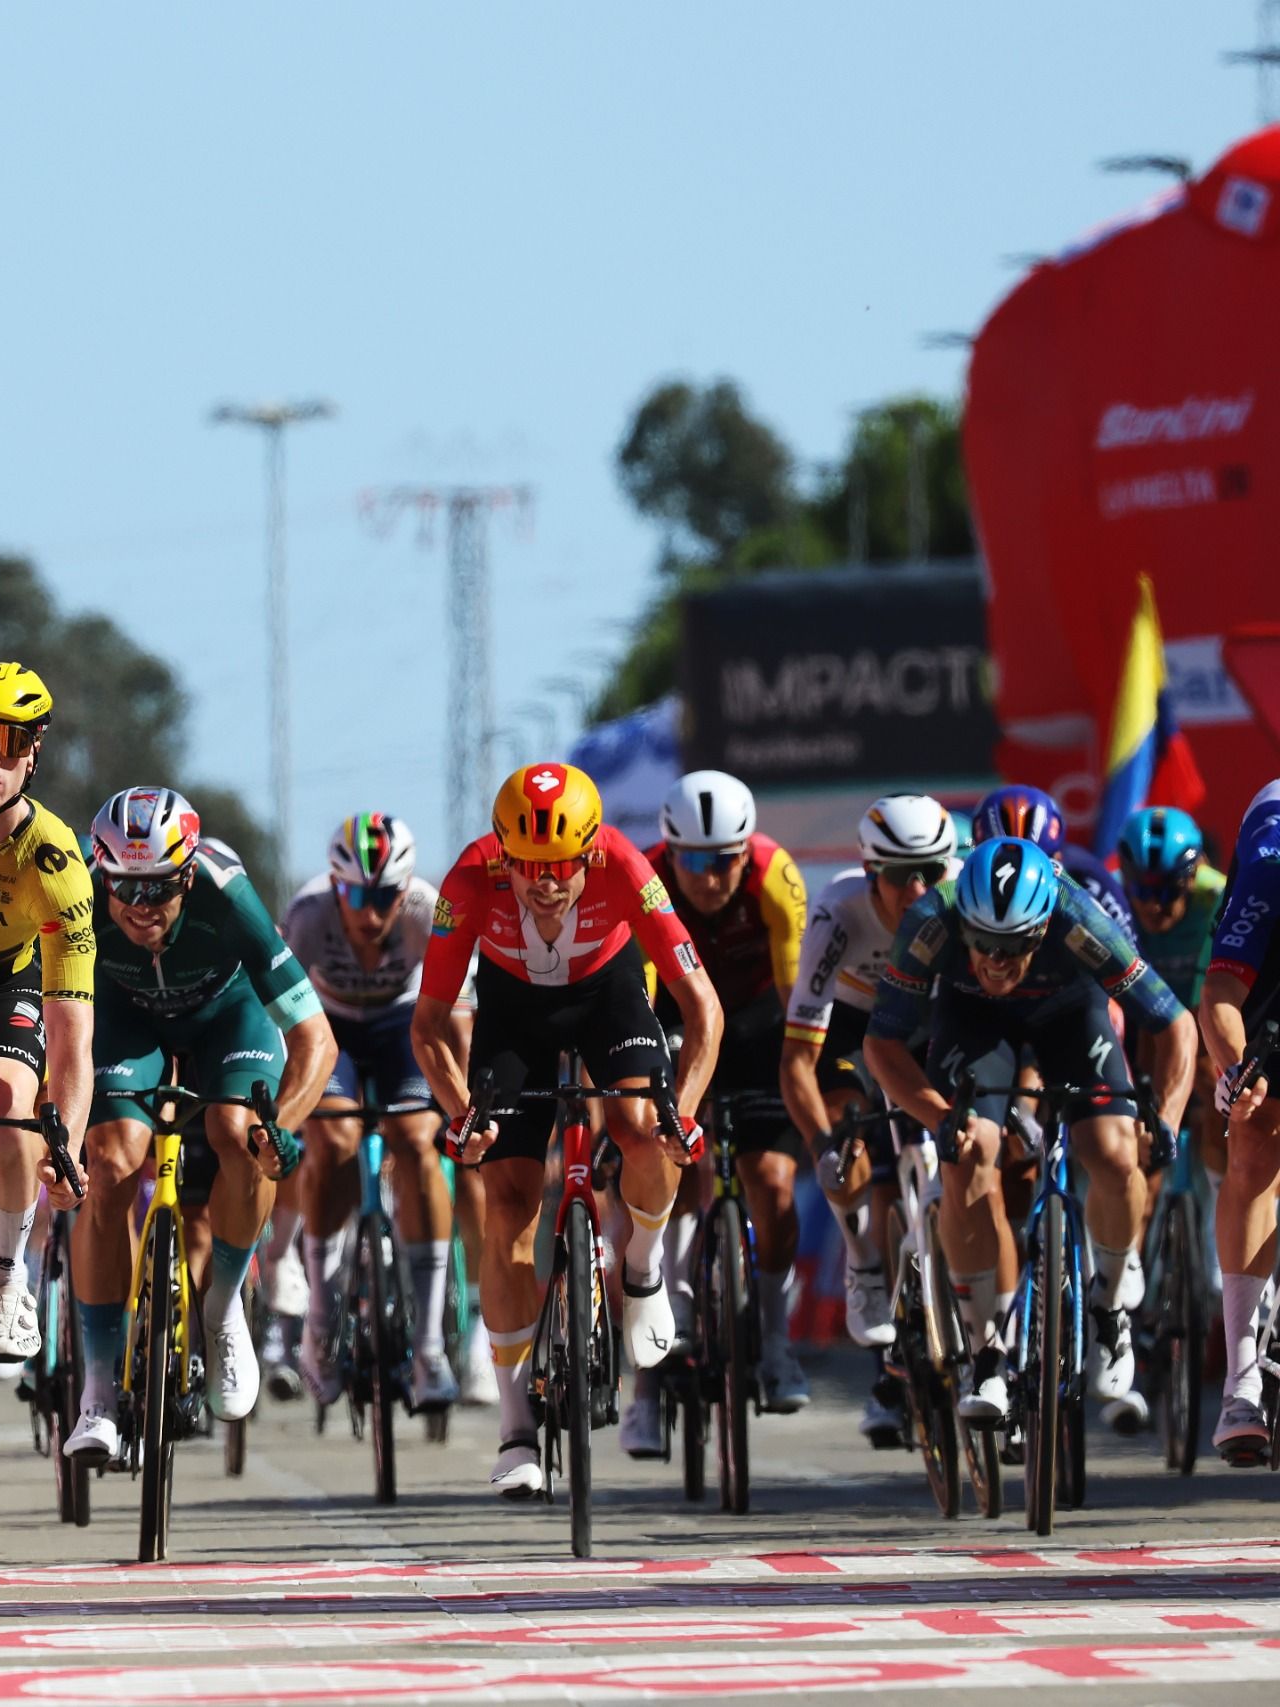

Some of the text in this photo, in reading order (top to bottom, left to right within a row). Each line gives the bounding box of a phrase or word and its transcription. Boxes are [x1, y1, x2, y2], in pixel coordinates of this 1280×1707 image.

[121, 850, 136, 860] Red
[1221, 896, 1270, 948] BOSS
[608, 1035, 657, 1057] FUSION
